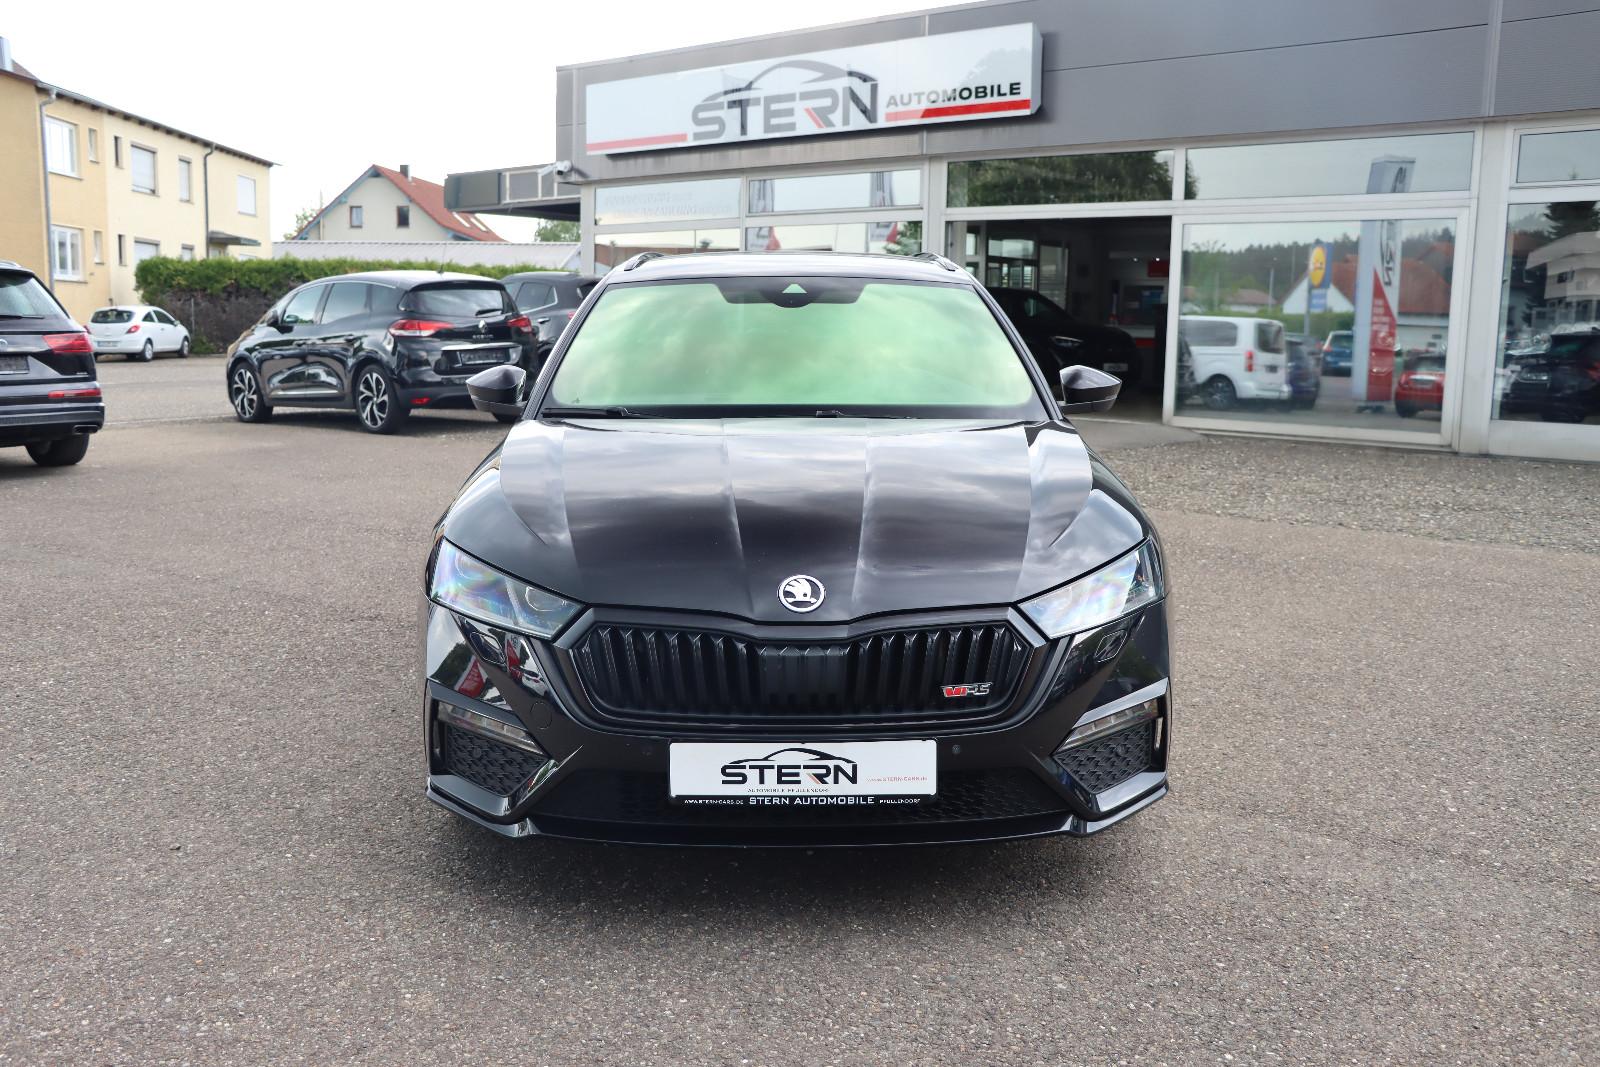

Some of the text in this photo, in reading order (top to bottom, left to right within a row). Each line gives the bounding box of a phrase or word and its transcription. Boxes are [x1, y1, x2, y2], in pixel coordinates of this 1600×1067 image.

[691, 81, 1022, 141] STERN AUTOMOBILE
[720, 763, 858, 785] STERN
[749, 796, 790, 805] STERN
[793, 796, 875, 805] AUTOMOBILE
